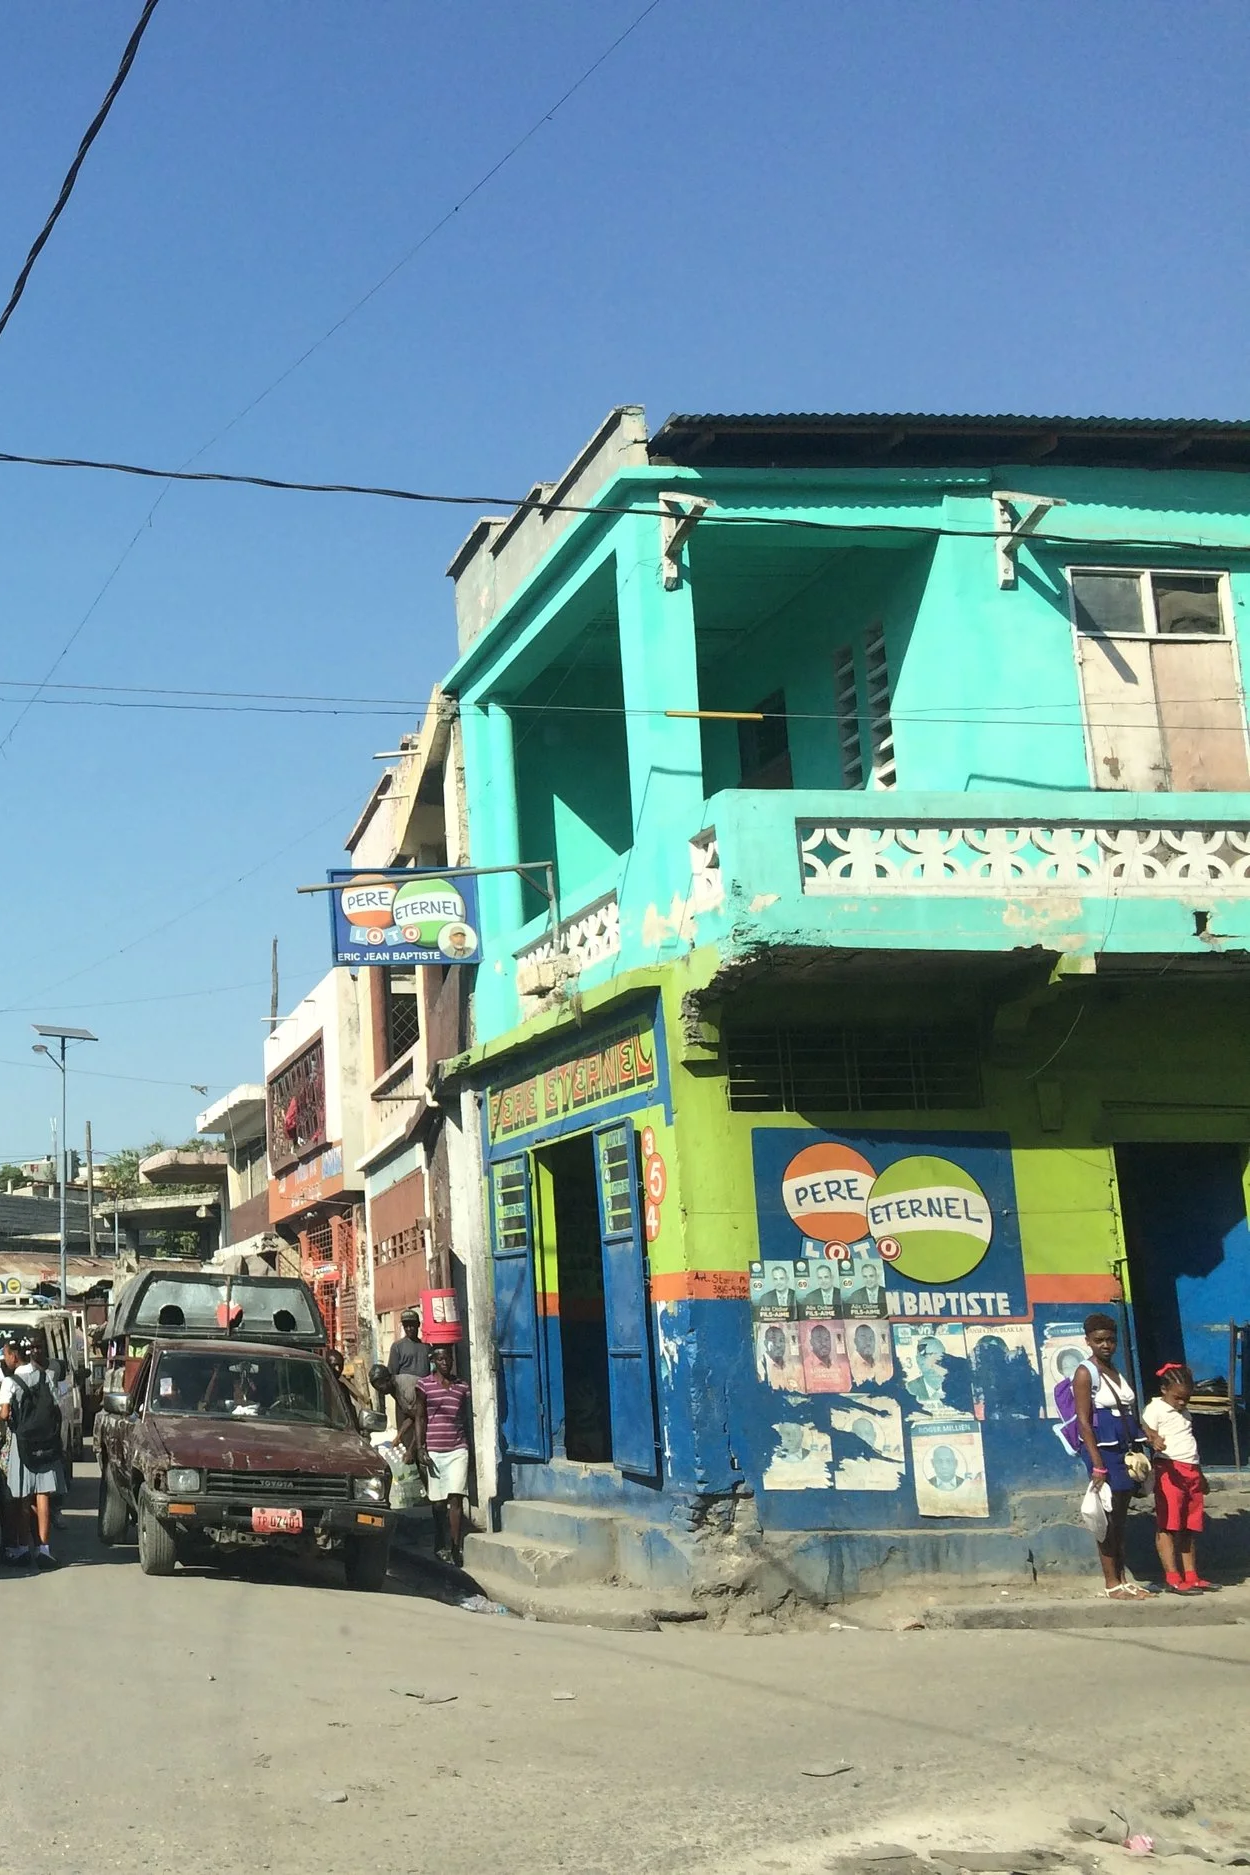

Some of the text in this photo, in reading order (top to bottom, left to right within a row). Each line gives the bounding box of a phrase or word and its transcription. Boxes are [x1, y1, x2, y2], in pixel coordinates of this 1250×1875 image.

[347, 891, 391, 909] PERE
[395, 900, 464, 920] ETERNEL
[353, 924, 421, 946] LOTO
[338, 951, 440, 961] ERIC JEAN BAPTISTE
[490, 1080, 538, 1133] PERE
[650, 1161, 663, 1197] 5
[795, 1178, 865, 1206] PERE
[646, 1208, 658, 1235] 4
[869, 1197, 984, 1225] ETERNEL
[805, 1236, 901, 1261] LOTO
[752, 1281, 763, 1289] 69
[797, 1280, 808, 1288] 69
[842, 1279, 853, 1287] 69
[902, 1292, 1012, 1316] BAPTISTE
[918, 1423, 971, 1433] ROGER MILLIEN
[260, 1480, 294, 1488] TOYOTA
